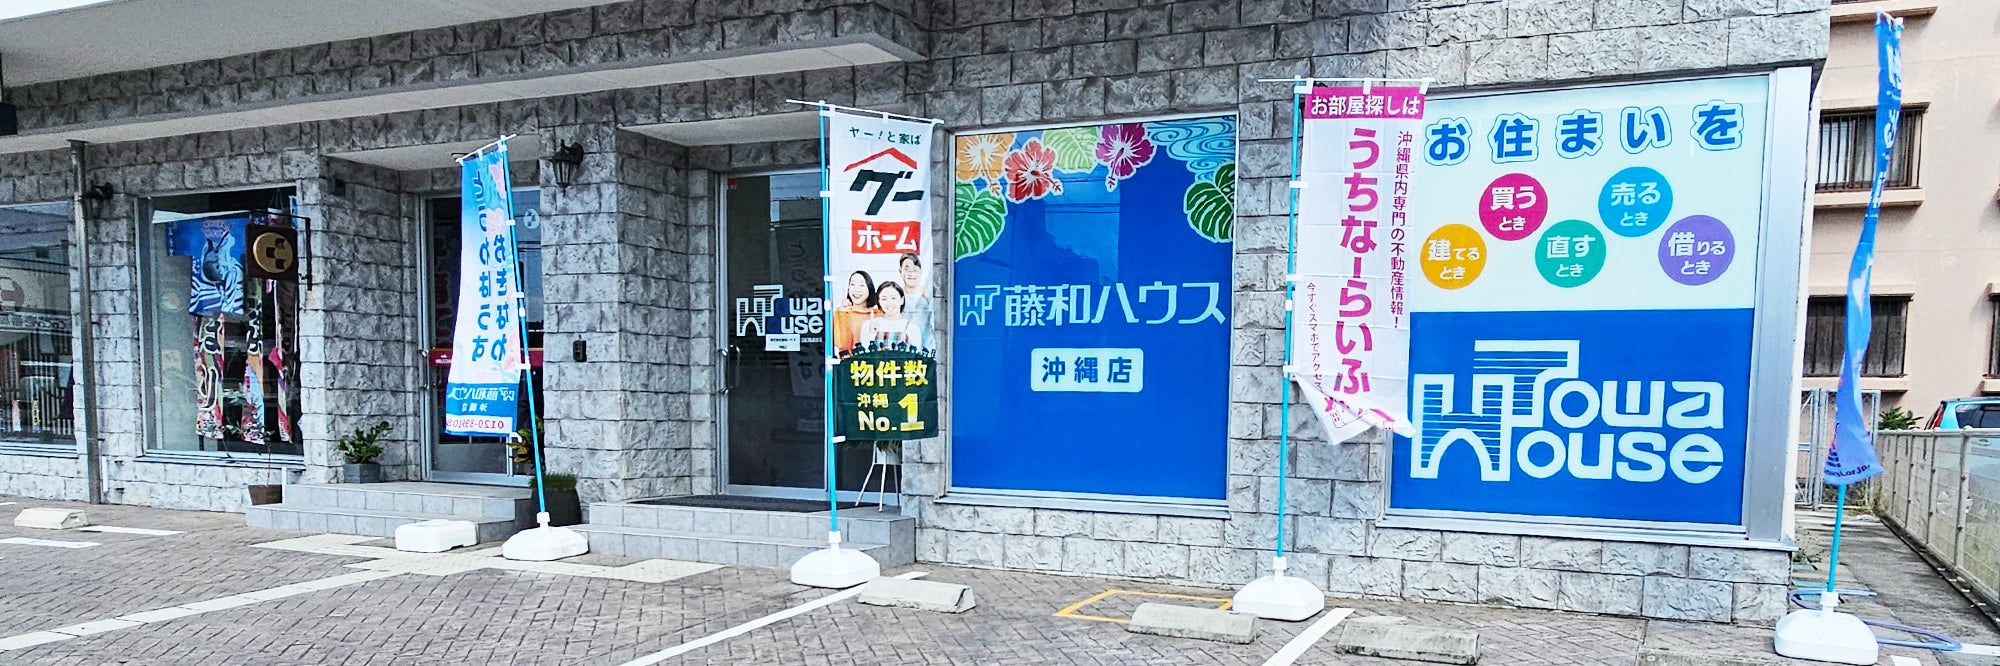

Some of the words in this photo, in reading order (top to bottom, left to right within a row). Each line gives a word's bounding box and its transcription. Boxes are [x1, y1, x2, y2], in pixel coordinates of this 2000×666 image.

[1310, 95, 1420, 115] お部屋探しは
[1426, 103, 1741, 164] お住まいを
[849, 169, 924, 215] グー
[1490, 186, 1537, 211] 買う
[1611, 182, 1661, 206] 売る
[1390, 130, 1413, 329] 沖縄県内専門の不動産情報！
[1499, 218, 1526, 231] とき
[1620, 213, 1649, 227] とき
[857, 224, 918, 251] ホーム
[1427, 238, 1480, 262] 建てる
[1546, 235, 1596, 259] 直す
[1668, 231, 1726, 257] 借りる
[1334, 127, 1380, 395] うちなーらいふ
[1439, 266, 1466, 280] とき
[1556, 264, 1584, 278] とき
[1680, 261, 1711, 275] とき
[1003, 281, 1226, 326] 藤和ハウス
[850, 360, 929, 387] 物件数
[1041, 356, 1133, 384] 沖縄店
[857, 393, 889, 408] 沖縄
[858, 393, 924, 432] No.1
